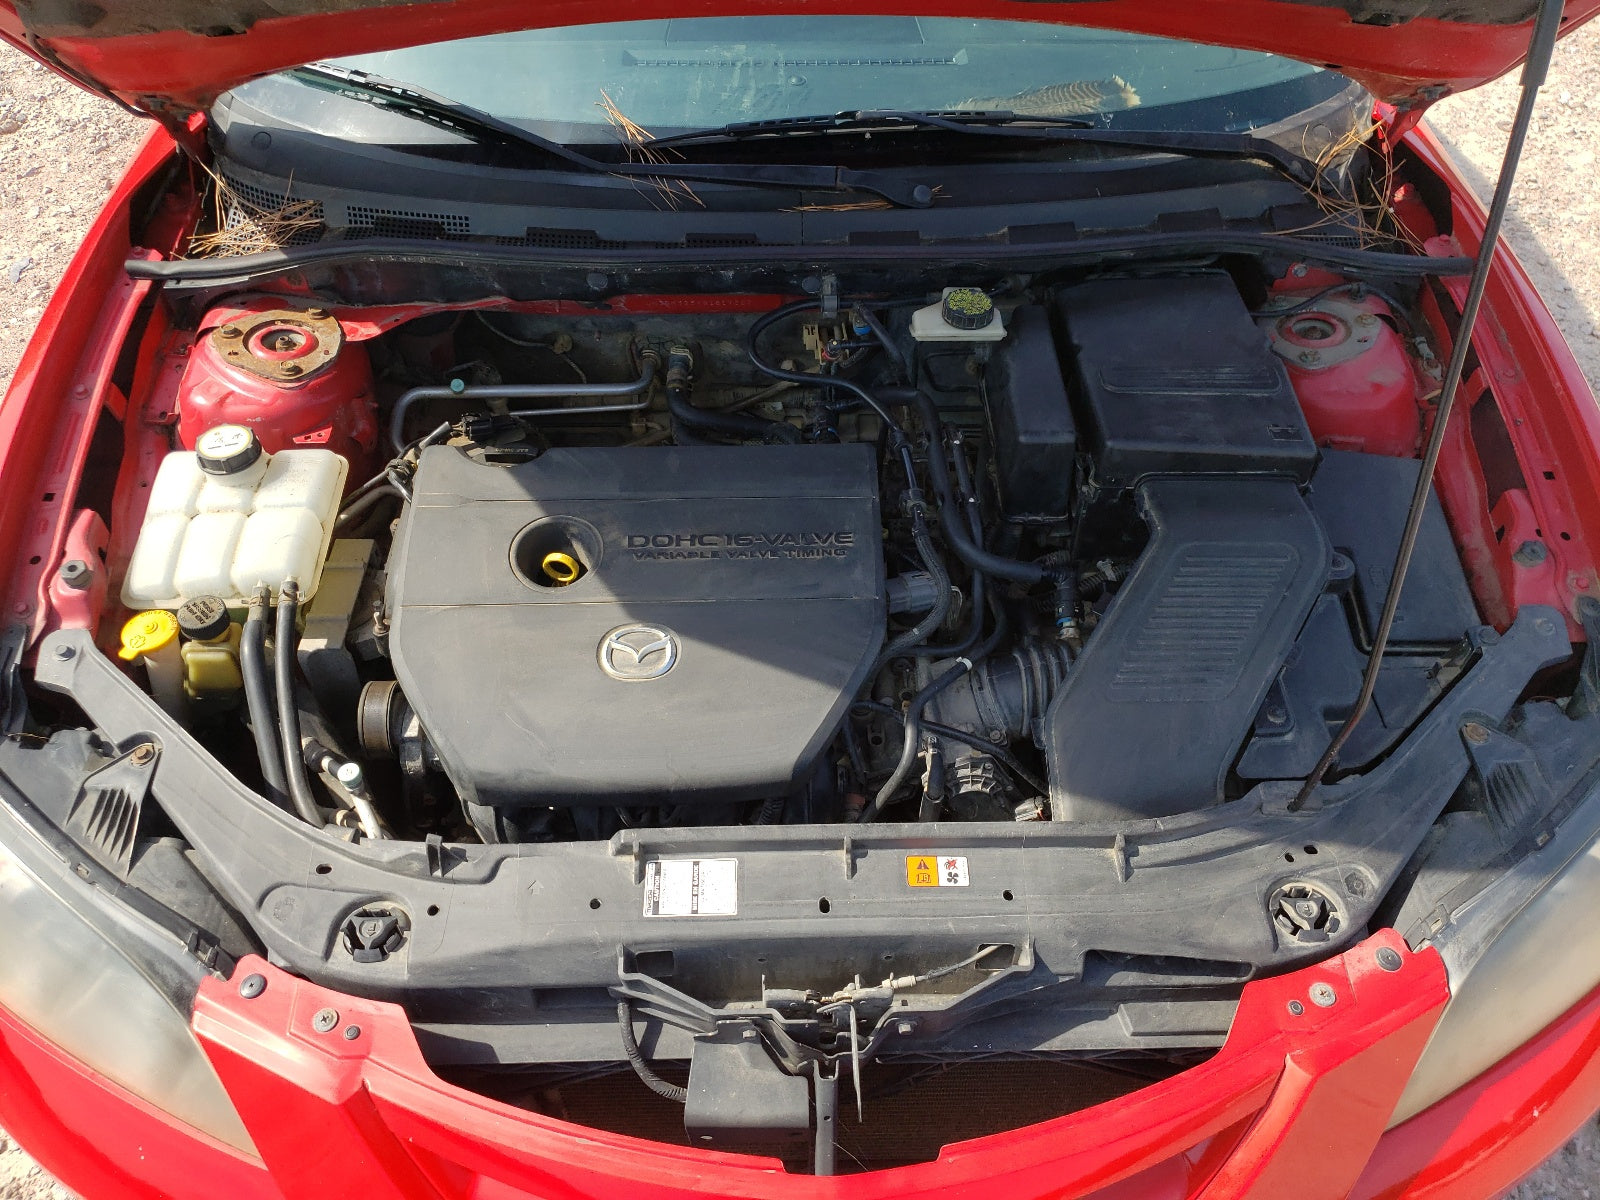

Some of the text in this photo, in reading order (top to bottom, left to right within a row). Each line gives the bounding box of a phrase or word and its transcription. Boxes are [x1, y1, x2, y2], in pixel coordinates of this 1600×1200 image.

[626, 532, 854, 548] DOHC 16-VALVE
[633, 548, 847, 560] VARIABLE VALVE TIMING
